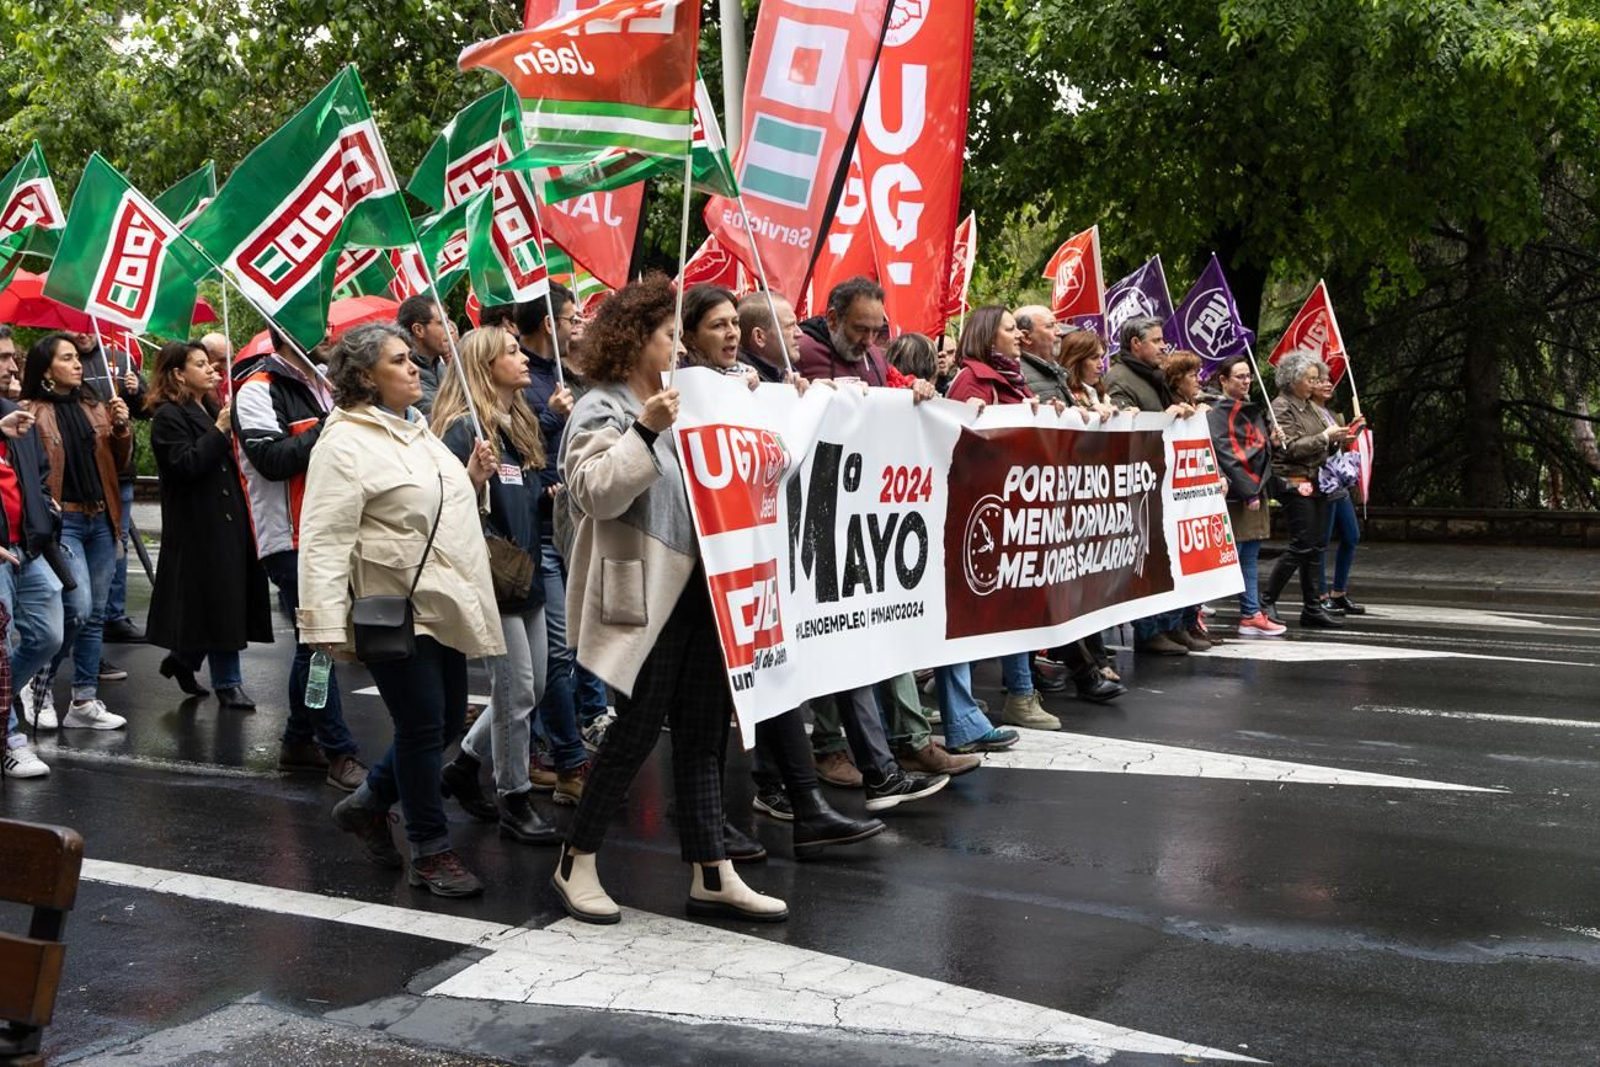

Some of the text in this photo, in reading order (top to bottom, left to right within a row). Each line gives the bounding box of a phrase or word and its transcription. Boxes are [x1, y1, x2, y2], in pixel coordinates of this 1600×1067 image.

[687, 427, 761, 490] UGT
[879, 465, 933, 503] 2024
[1003, 465, 1056, 502] POR
[1180, 517, 1210, 554] UGT
[997, 534, 1139, 590] MEJORES SALARIOS
